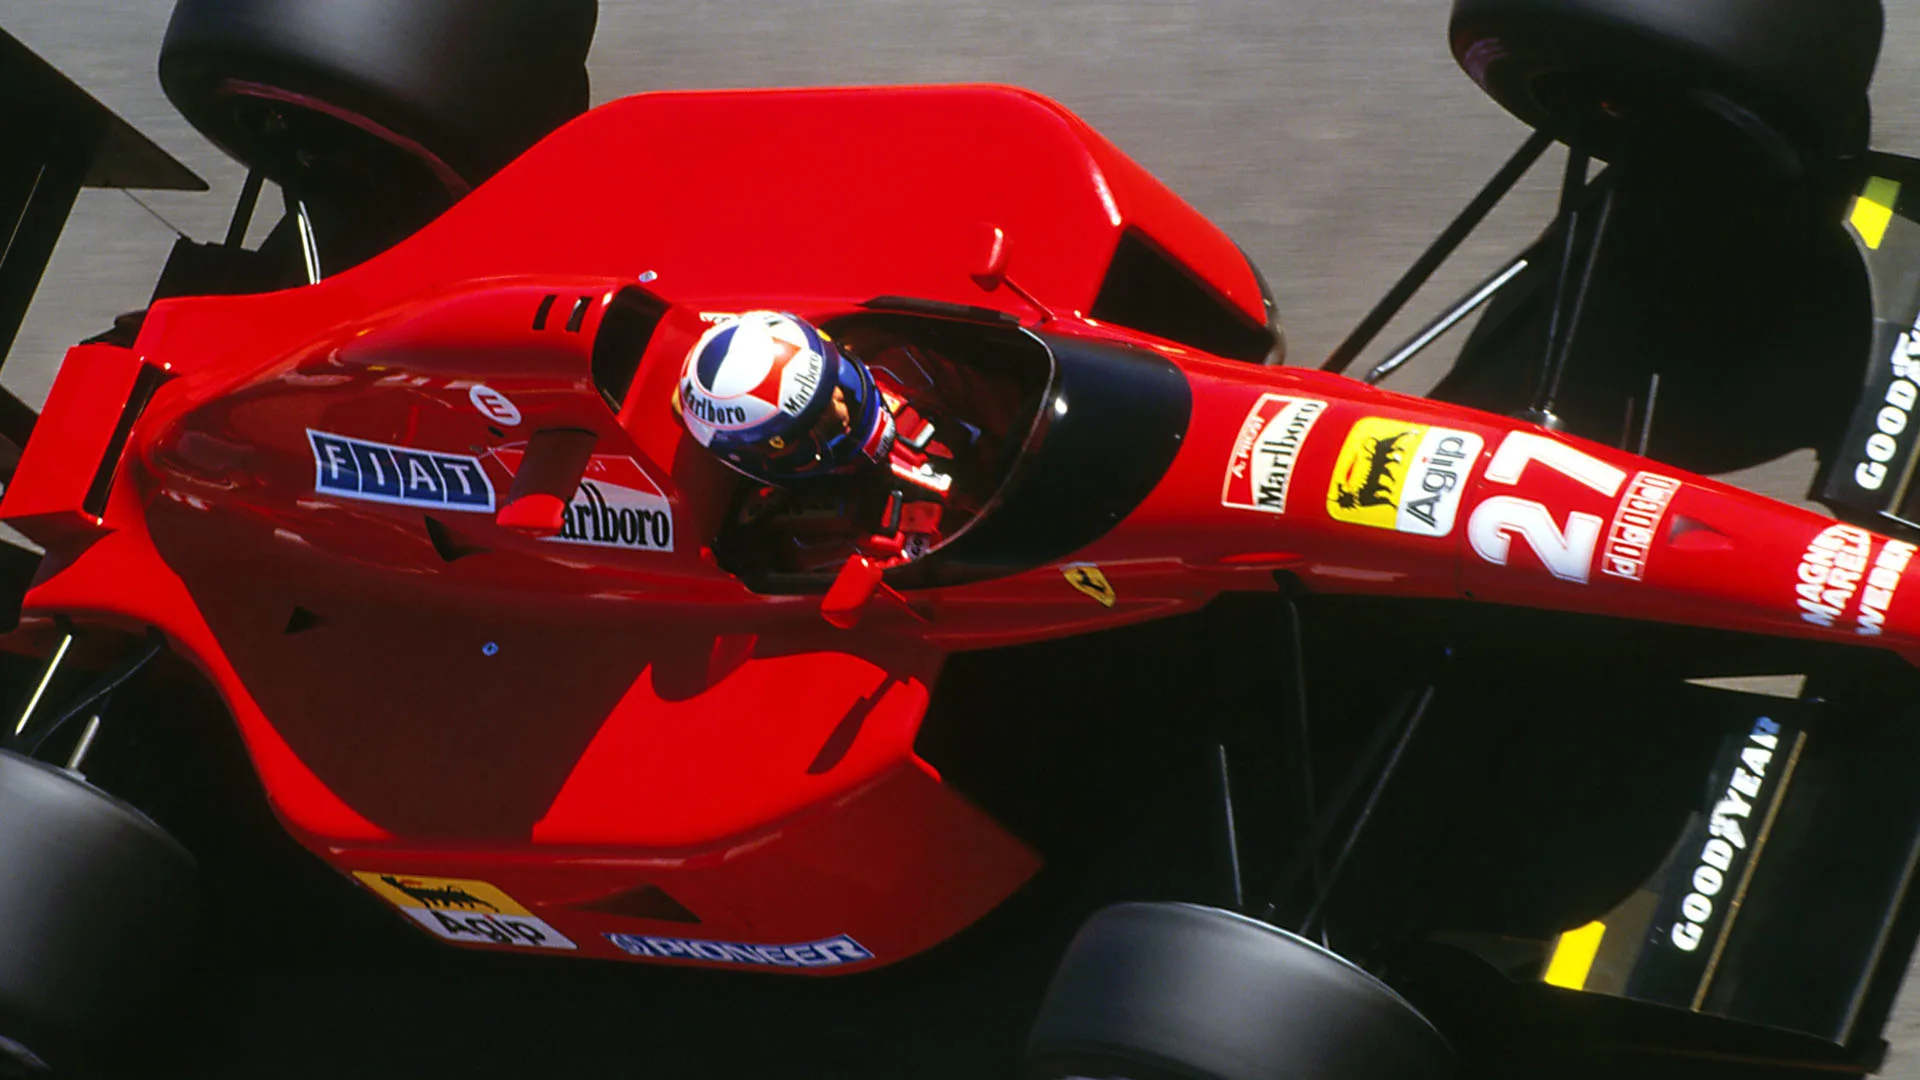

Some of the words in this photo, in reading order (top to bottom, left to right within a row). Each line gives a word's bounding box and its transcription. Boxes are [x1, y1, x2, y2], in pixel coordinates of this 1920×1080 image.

[783, 352, 820, 417] Marlboro
[320, 441, 474, 497] FIAT
[1257, 403, 1320, 509] Marlboro
[1405, 436, 1464, 528] Agip
[558, 481, 670, 548] arlboro
[1467, 430, 1627, 584] 27
[1671, 715, 1782, 952] GOODYEAR
[430, 909, 547, 945] Agip
[638, 934, 872, 967] PIONEER
